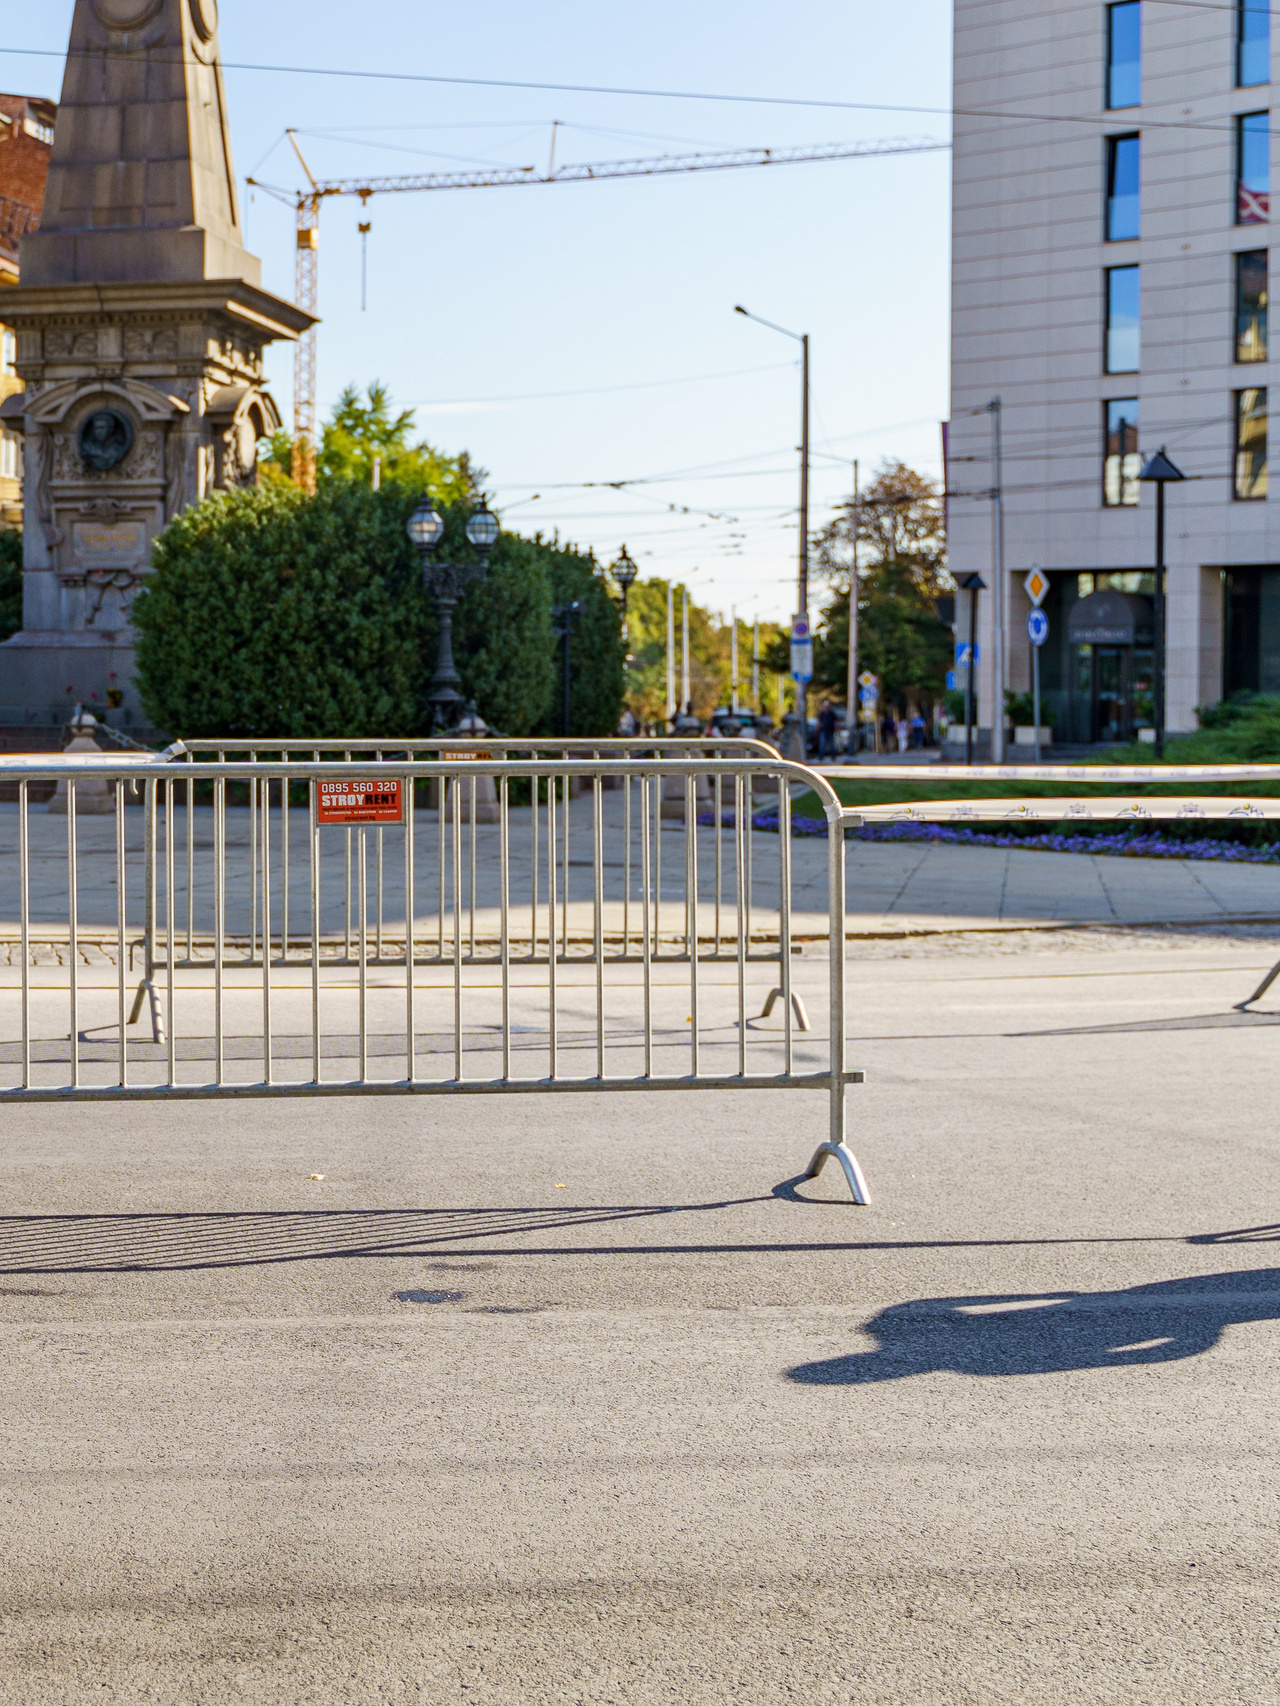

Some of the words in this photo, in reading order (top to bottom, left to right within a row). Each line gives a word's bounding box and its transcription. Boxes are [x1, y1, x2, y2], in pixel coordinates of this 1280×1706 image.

[321, 783, 349, 793] 0895
[352, 782, 373, 792] 560
[377, 781, 397, 792] 320
[322, 794, 396, 806] STROYRENT
